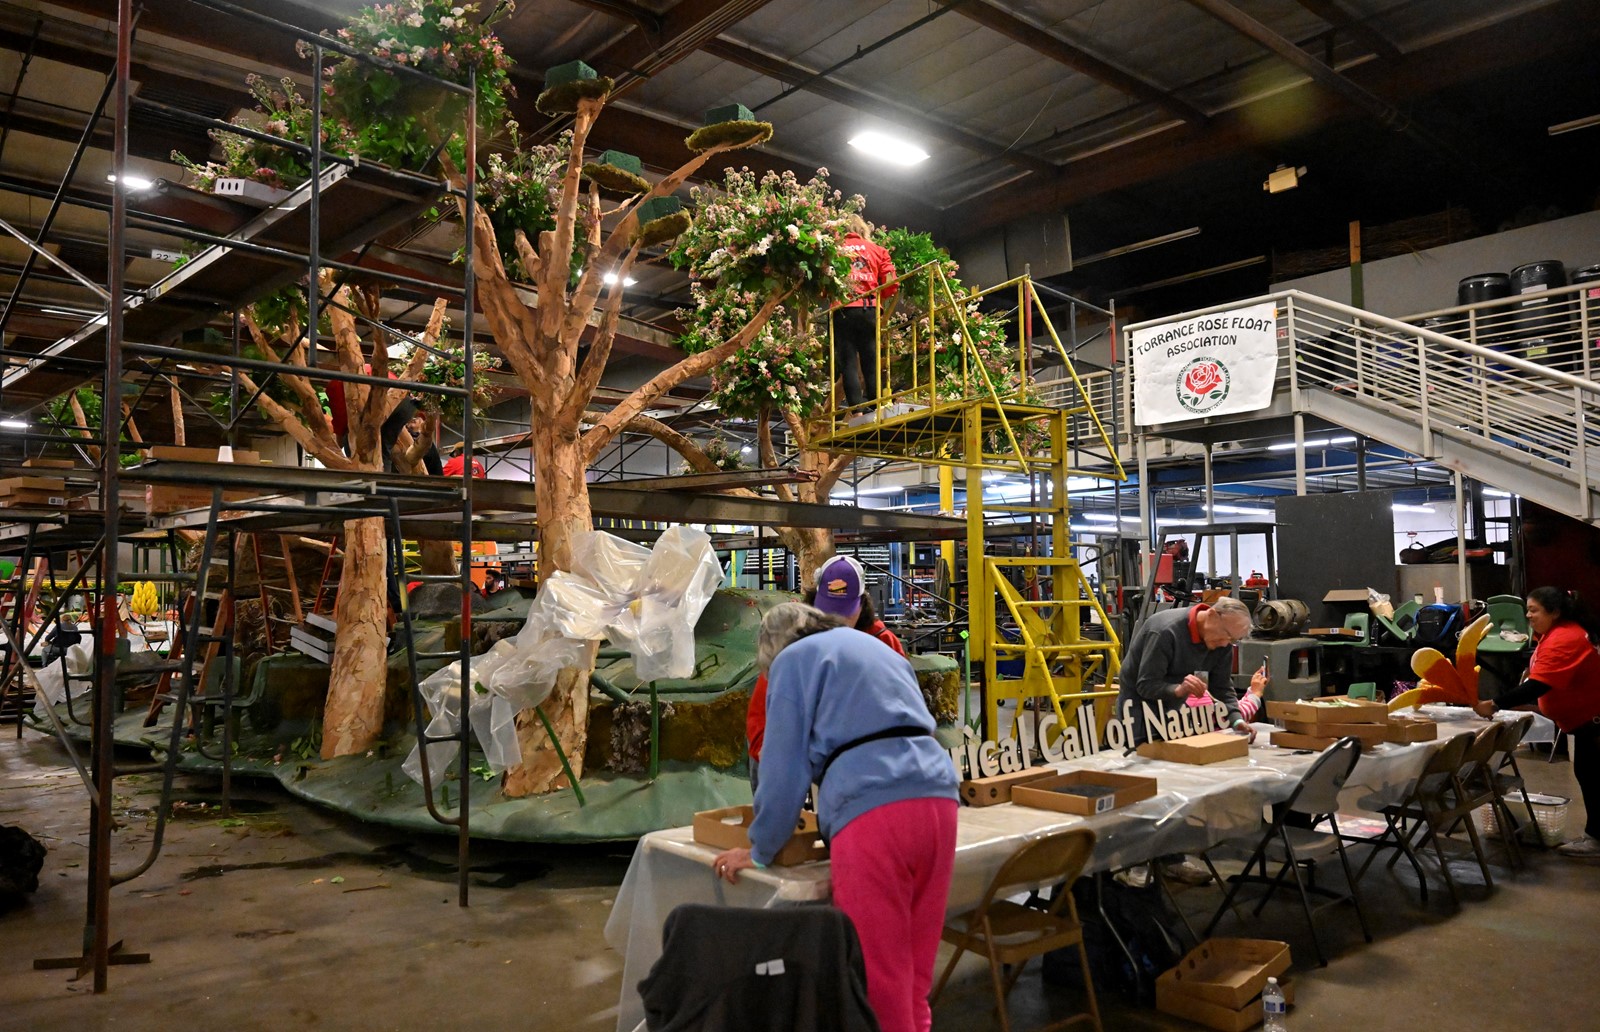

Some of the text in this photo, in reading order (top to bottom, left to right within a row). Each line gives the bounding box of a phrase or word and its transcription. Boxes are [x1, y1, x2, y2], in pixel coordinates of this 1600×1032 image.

[1137, 317, 1272, 355] TORRANCE ROSE FLOAT
[1167, 335, 1237, 358] ASSOCIATION
[947, 698, 1231, 782] rical Call of Nature
